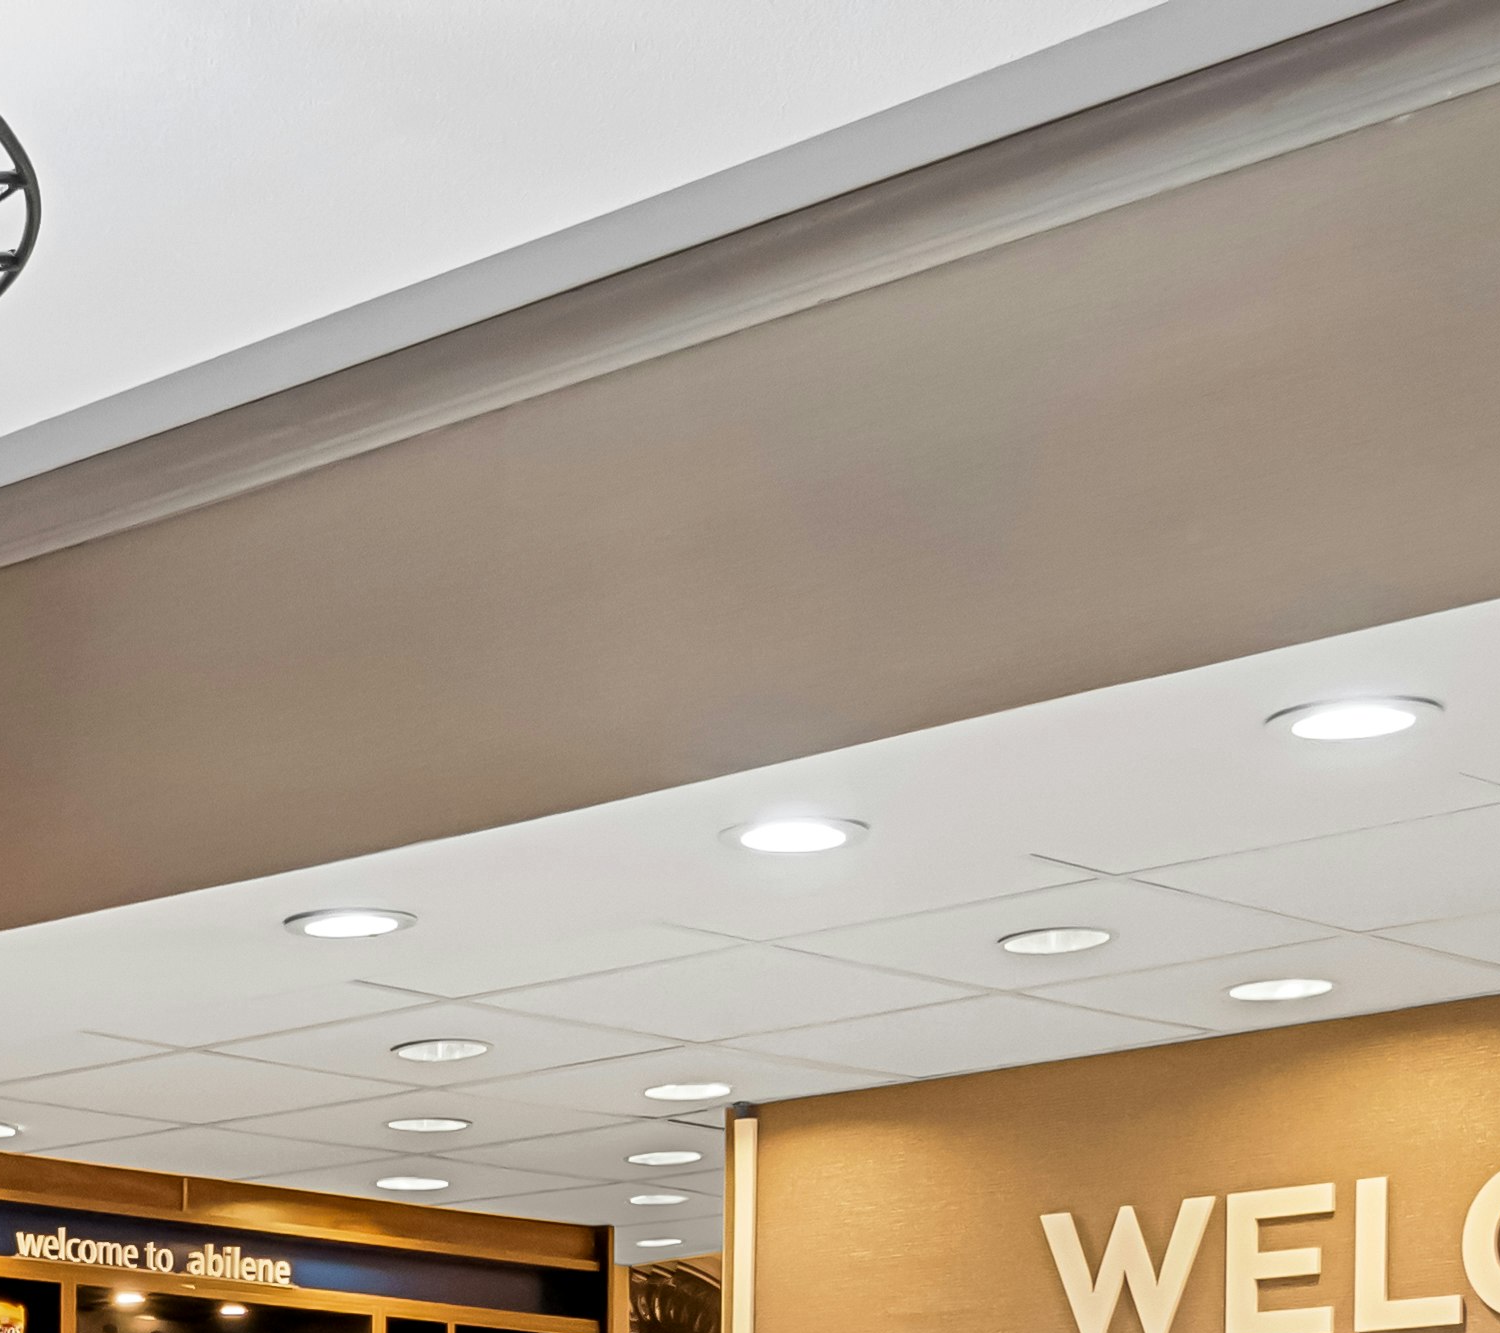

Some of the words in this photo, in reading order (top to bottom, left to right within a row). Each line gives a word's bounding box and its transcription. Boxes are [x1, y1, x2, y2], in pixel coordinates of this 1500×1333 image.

[16, 1227, 139, 1269] welcome
[145, 1241, 174, 1273] to
[187, 1243, 291, 1284] abilene
